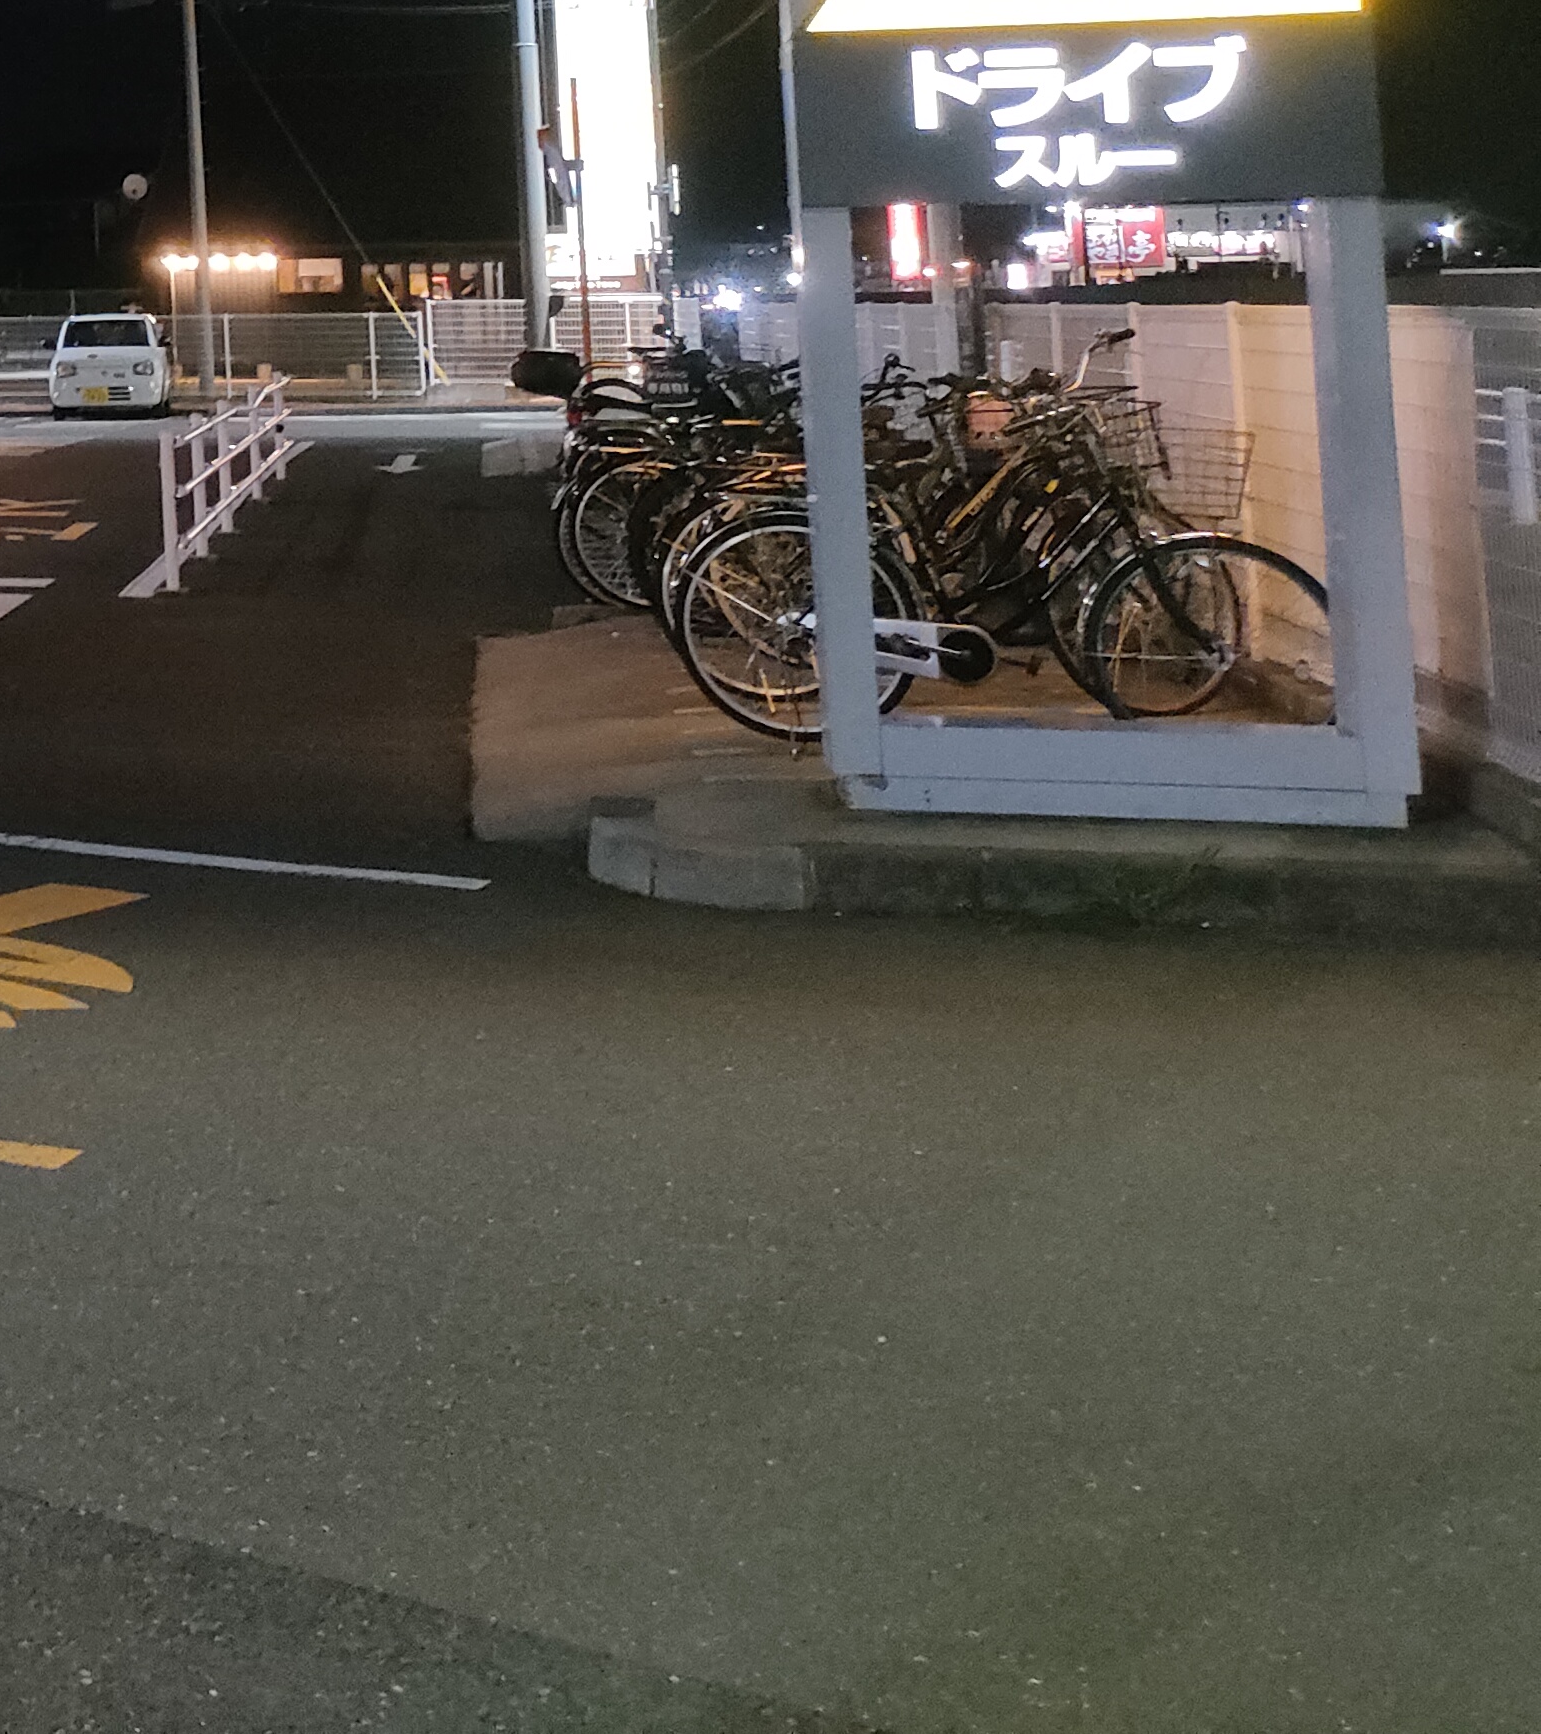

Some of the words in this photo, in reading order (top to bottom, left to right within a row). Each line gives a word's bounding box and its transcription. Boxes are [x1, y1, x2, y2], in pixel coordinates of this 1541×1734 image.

[910, 34, 1248, 130] ドライブ
[993, 132, 1178, 188] スルー
